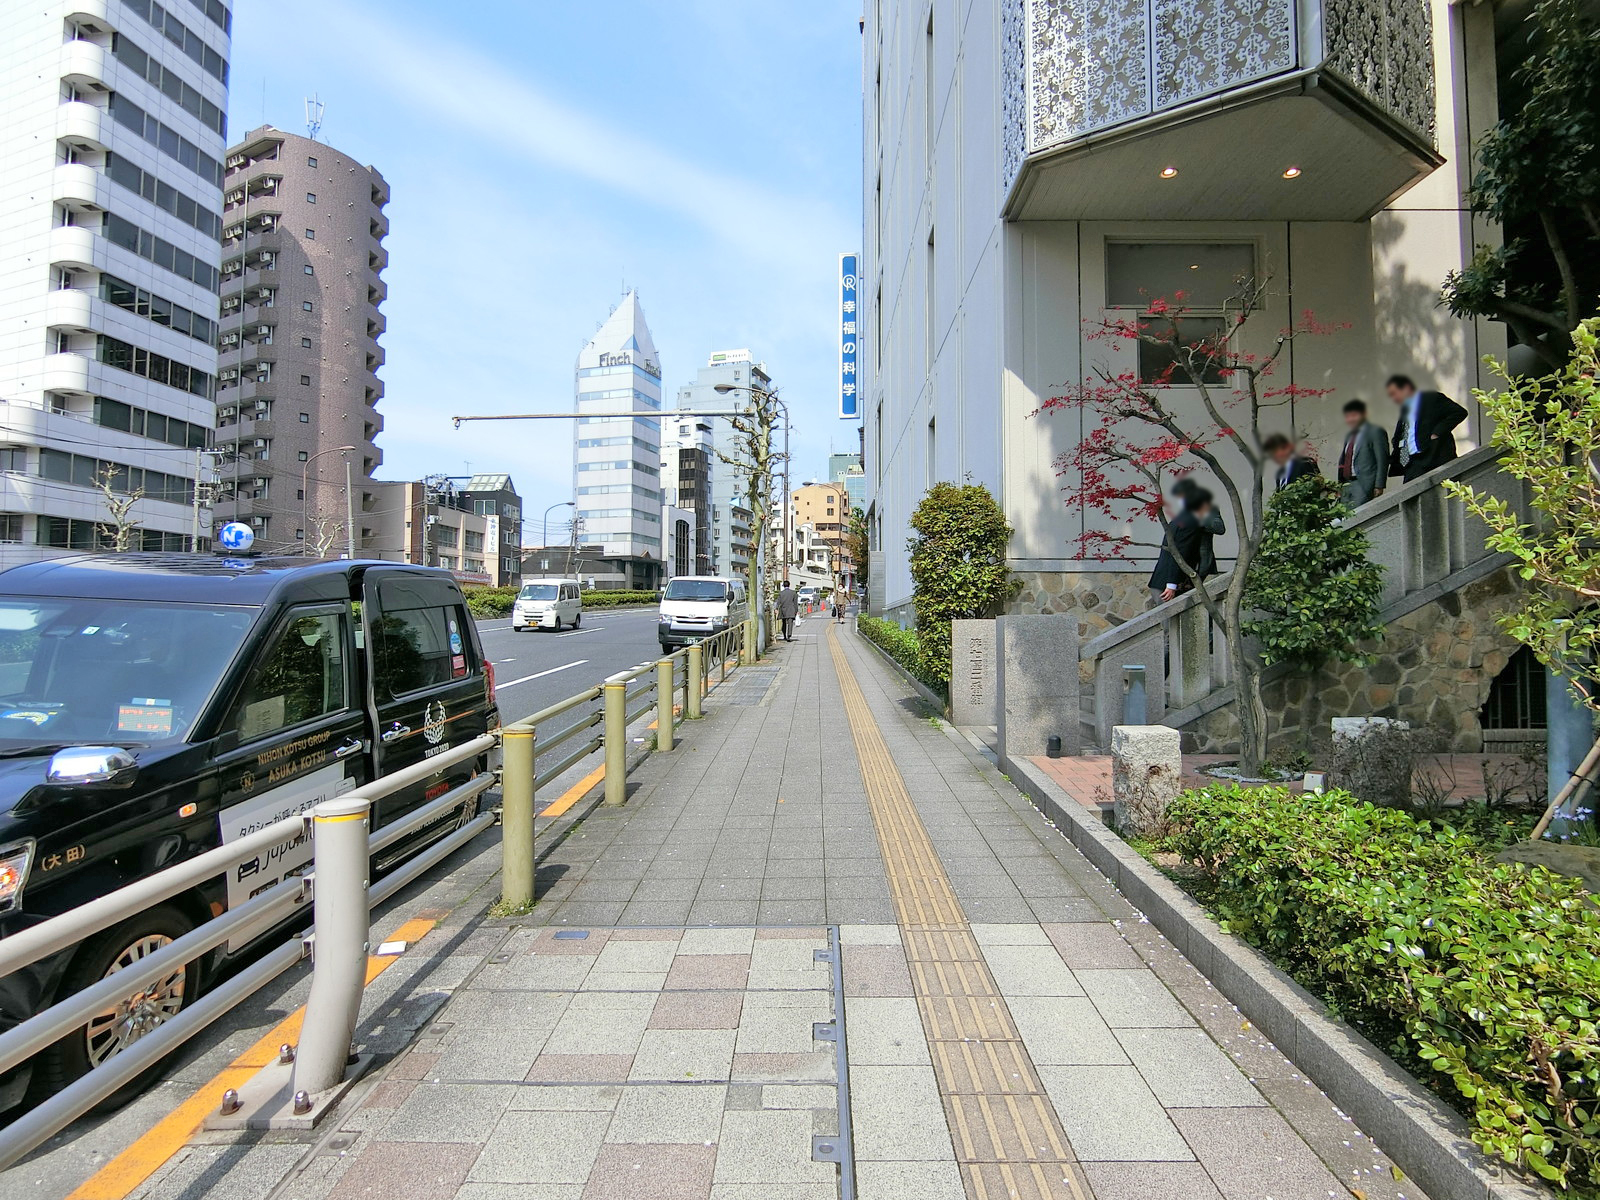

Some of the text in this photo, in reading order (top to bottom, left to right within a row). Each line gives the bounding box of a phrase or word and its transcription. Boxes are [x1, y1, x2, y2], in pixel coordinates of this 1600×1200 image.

[599, 351, 631, 367] Finch
[842, 300, 857, 397] 幸福の科学
[257, 730, 331, 765] NIHON KOTSU GROUP
[425, 742, 449, 758] TOKYO 2020
[268, 749, 326, 783] ASUKA KOTSU
